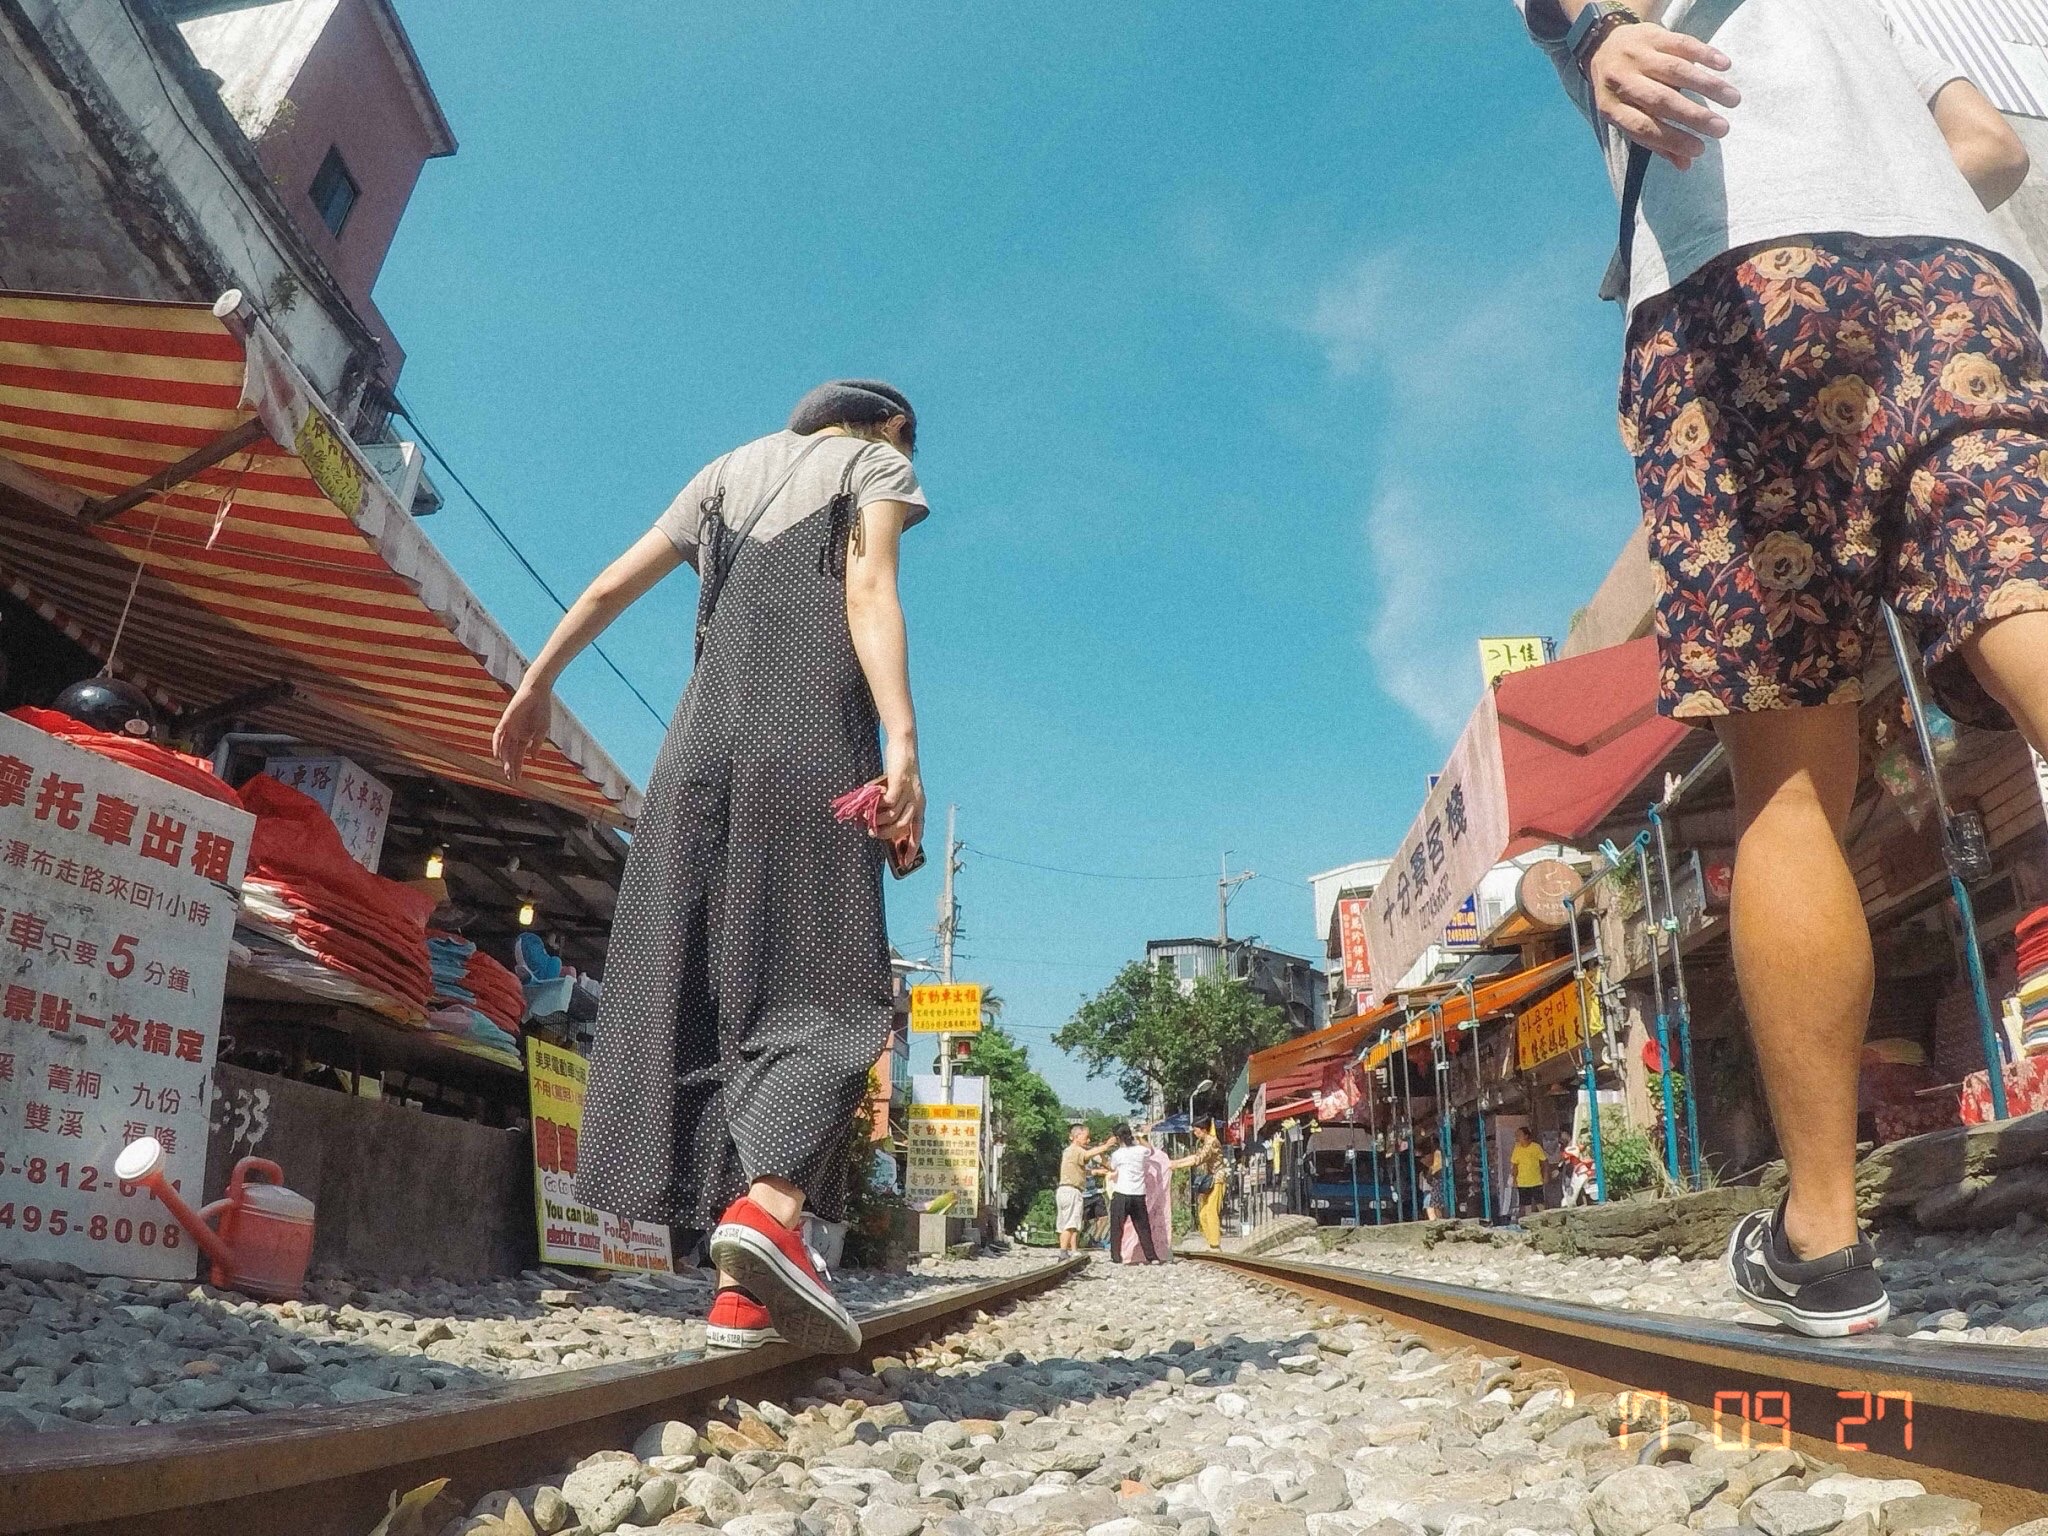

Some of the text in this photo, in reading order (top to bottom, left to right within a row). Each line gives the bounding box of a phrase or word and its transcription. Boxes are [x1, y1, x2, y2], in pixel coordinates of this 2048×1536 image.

[0, 754, 236, 884] 摩托車出租
[0, 838, 212, 928] 瀑布走路來回1小時
[3, 983, 206, 1064] 景點一次搞定
[545, 1199, 564, 1220] You
[566, 1206, 582, 1223] can
